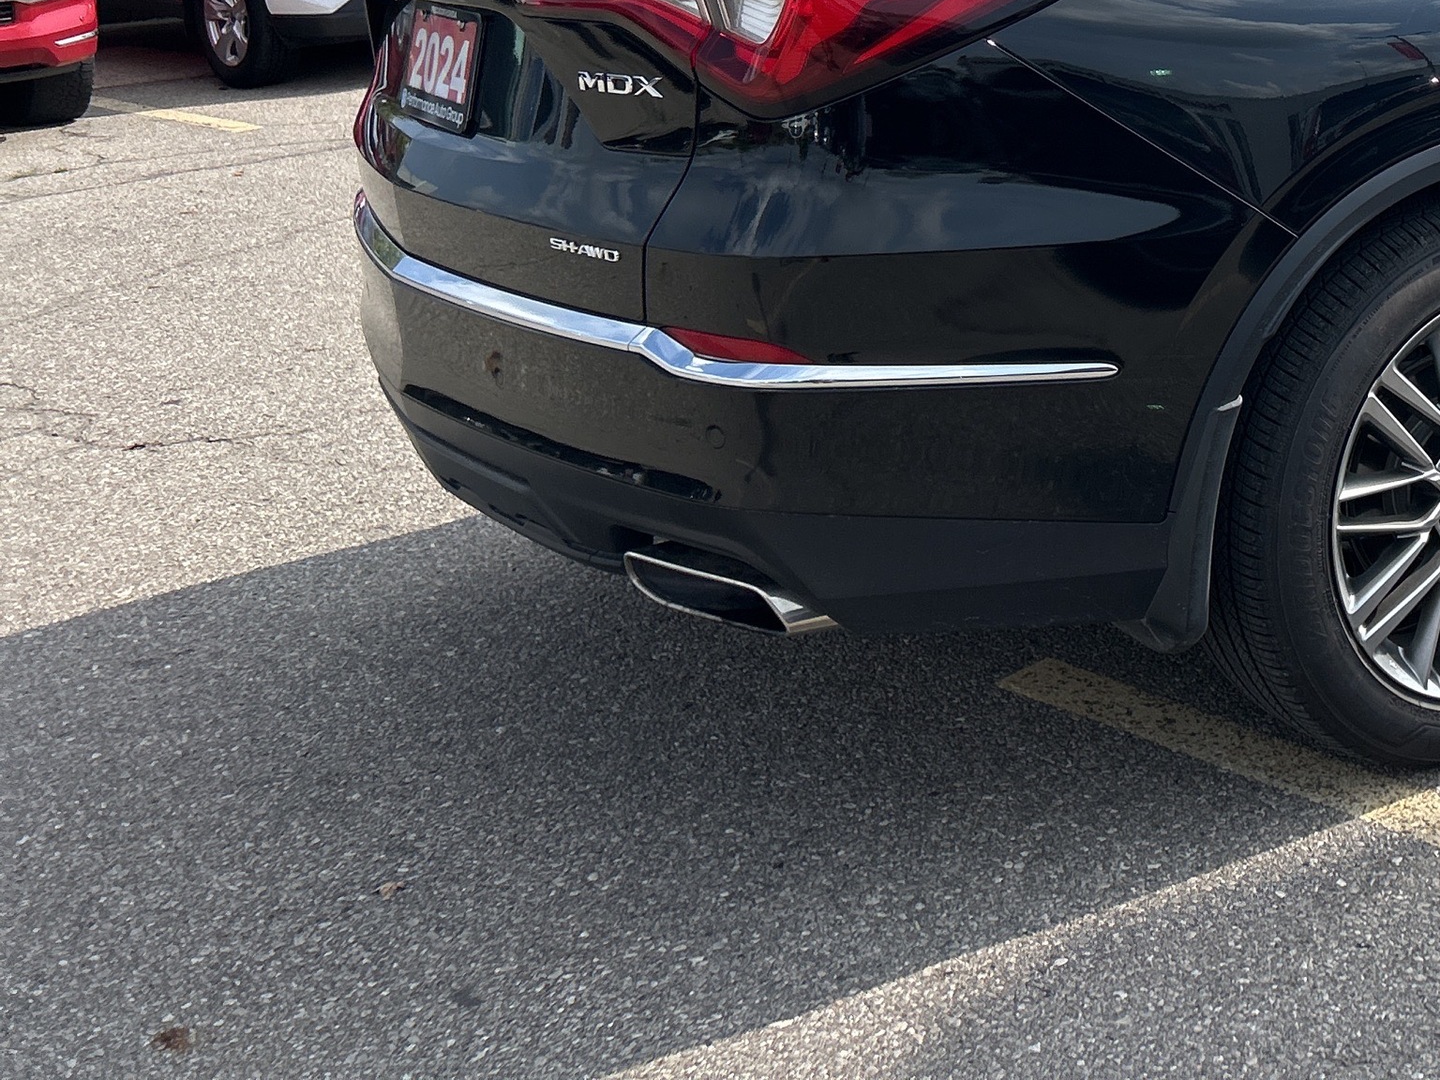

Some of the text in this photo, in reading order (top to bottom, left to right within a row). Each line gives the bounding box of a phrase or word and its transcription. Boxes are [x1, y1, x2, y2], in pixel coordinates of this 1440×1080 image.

[409, 27, 470, 104] 2024
[577, 71, 663, 99] MDX
[407, 91, 464, 129] Performance Auto Group
[549, 237, 620, 262] SH-AWD
